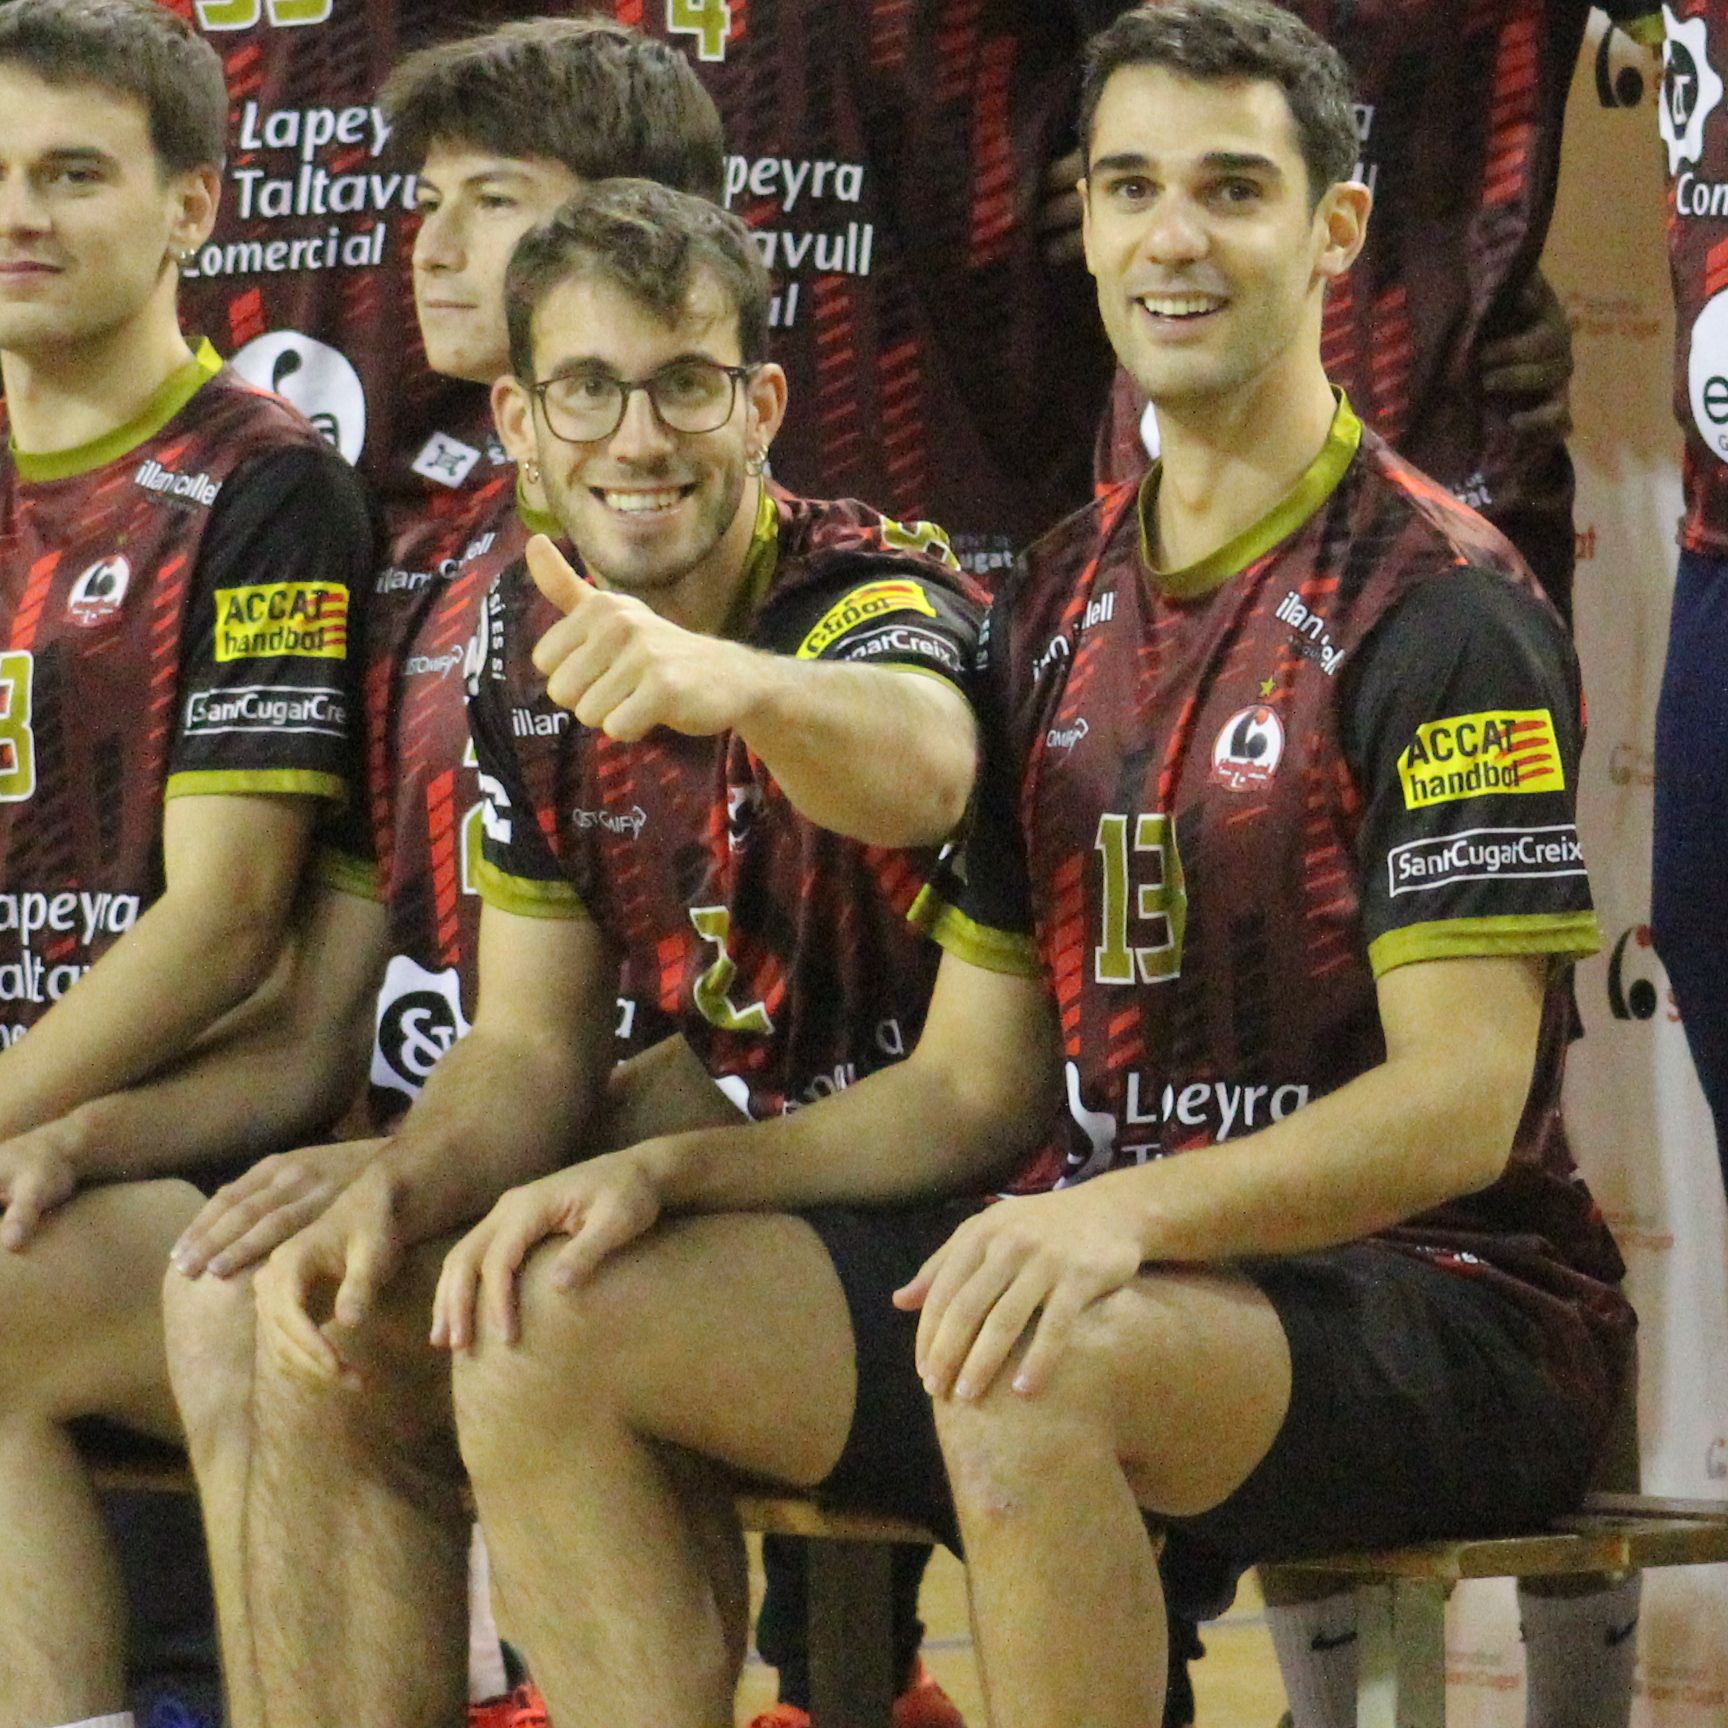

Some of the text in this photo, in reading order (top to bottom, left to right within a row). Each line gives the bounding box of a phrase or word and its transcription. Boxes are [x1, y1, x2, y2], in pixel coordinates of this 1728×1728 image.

[239, 100, 393, 162] Lapey
[723, 153, 865, 214] peyra
[182, 222, 386, 278] omercial
[223, 588, 330, 626] ACCAT
[224, 626, 328, 655] handbol
[1407, 718, 1519, 770] ACCAT
[1410, 758, 1520, 803] handbol
[1094, 812, 1187, 986] 13
